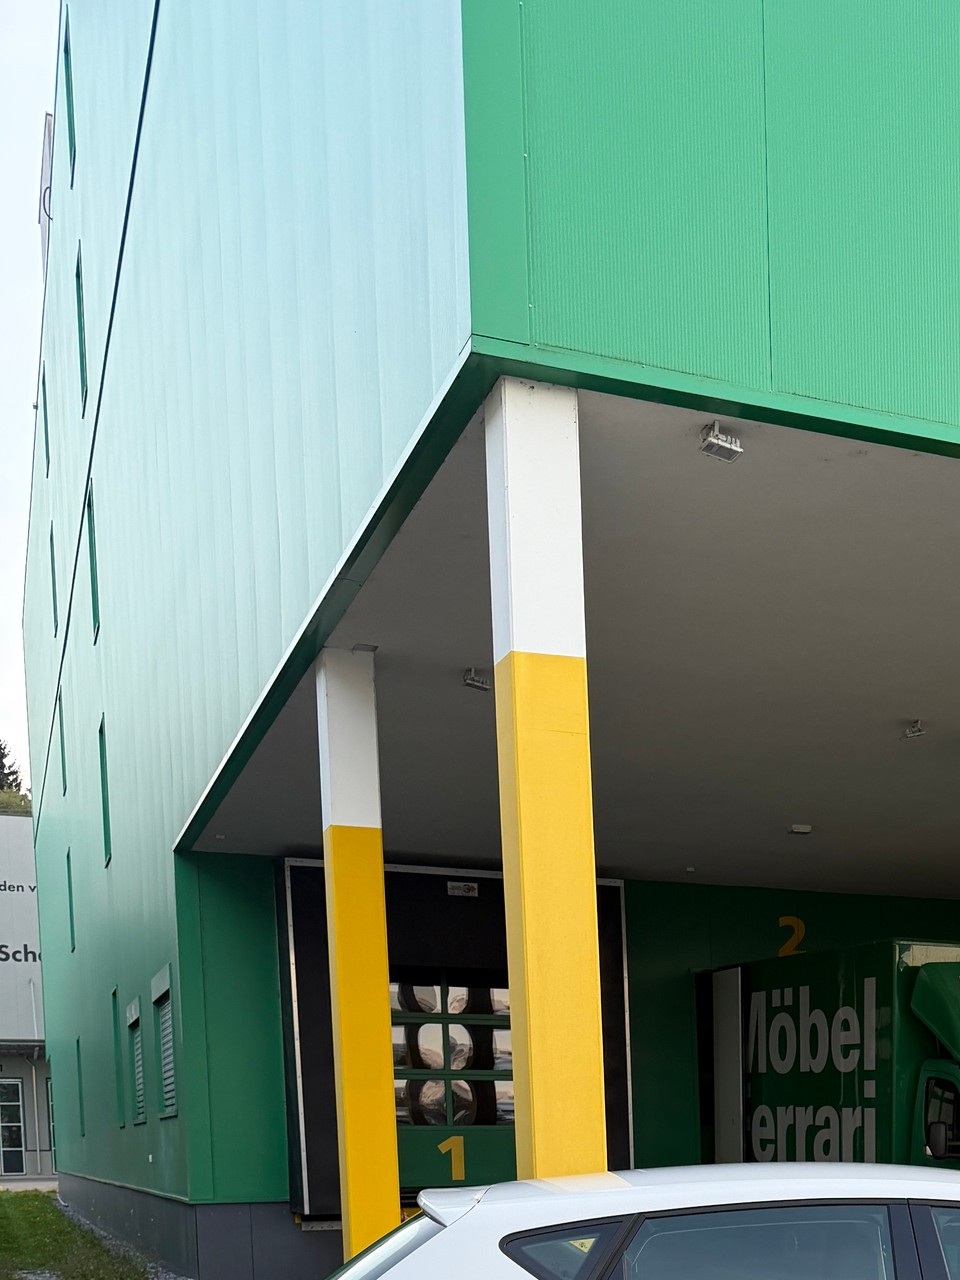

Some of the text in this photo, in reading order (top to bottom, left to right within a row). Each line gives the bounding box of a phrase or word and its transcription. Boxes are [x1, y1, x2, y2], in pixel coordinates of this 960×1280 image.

[778, 916, 806, 957] 2
[751, 1080, 877, 1163] errari
[437, 1135, 465, 1181] 1
